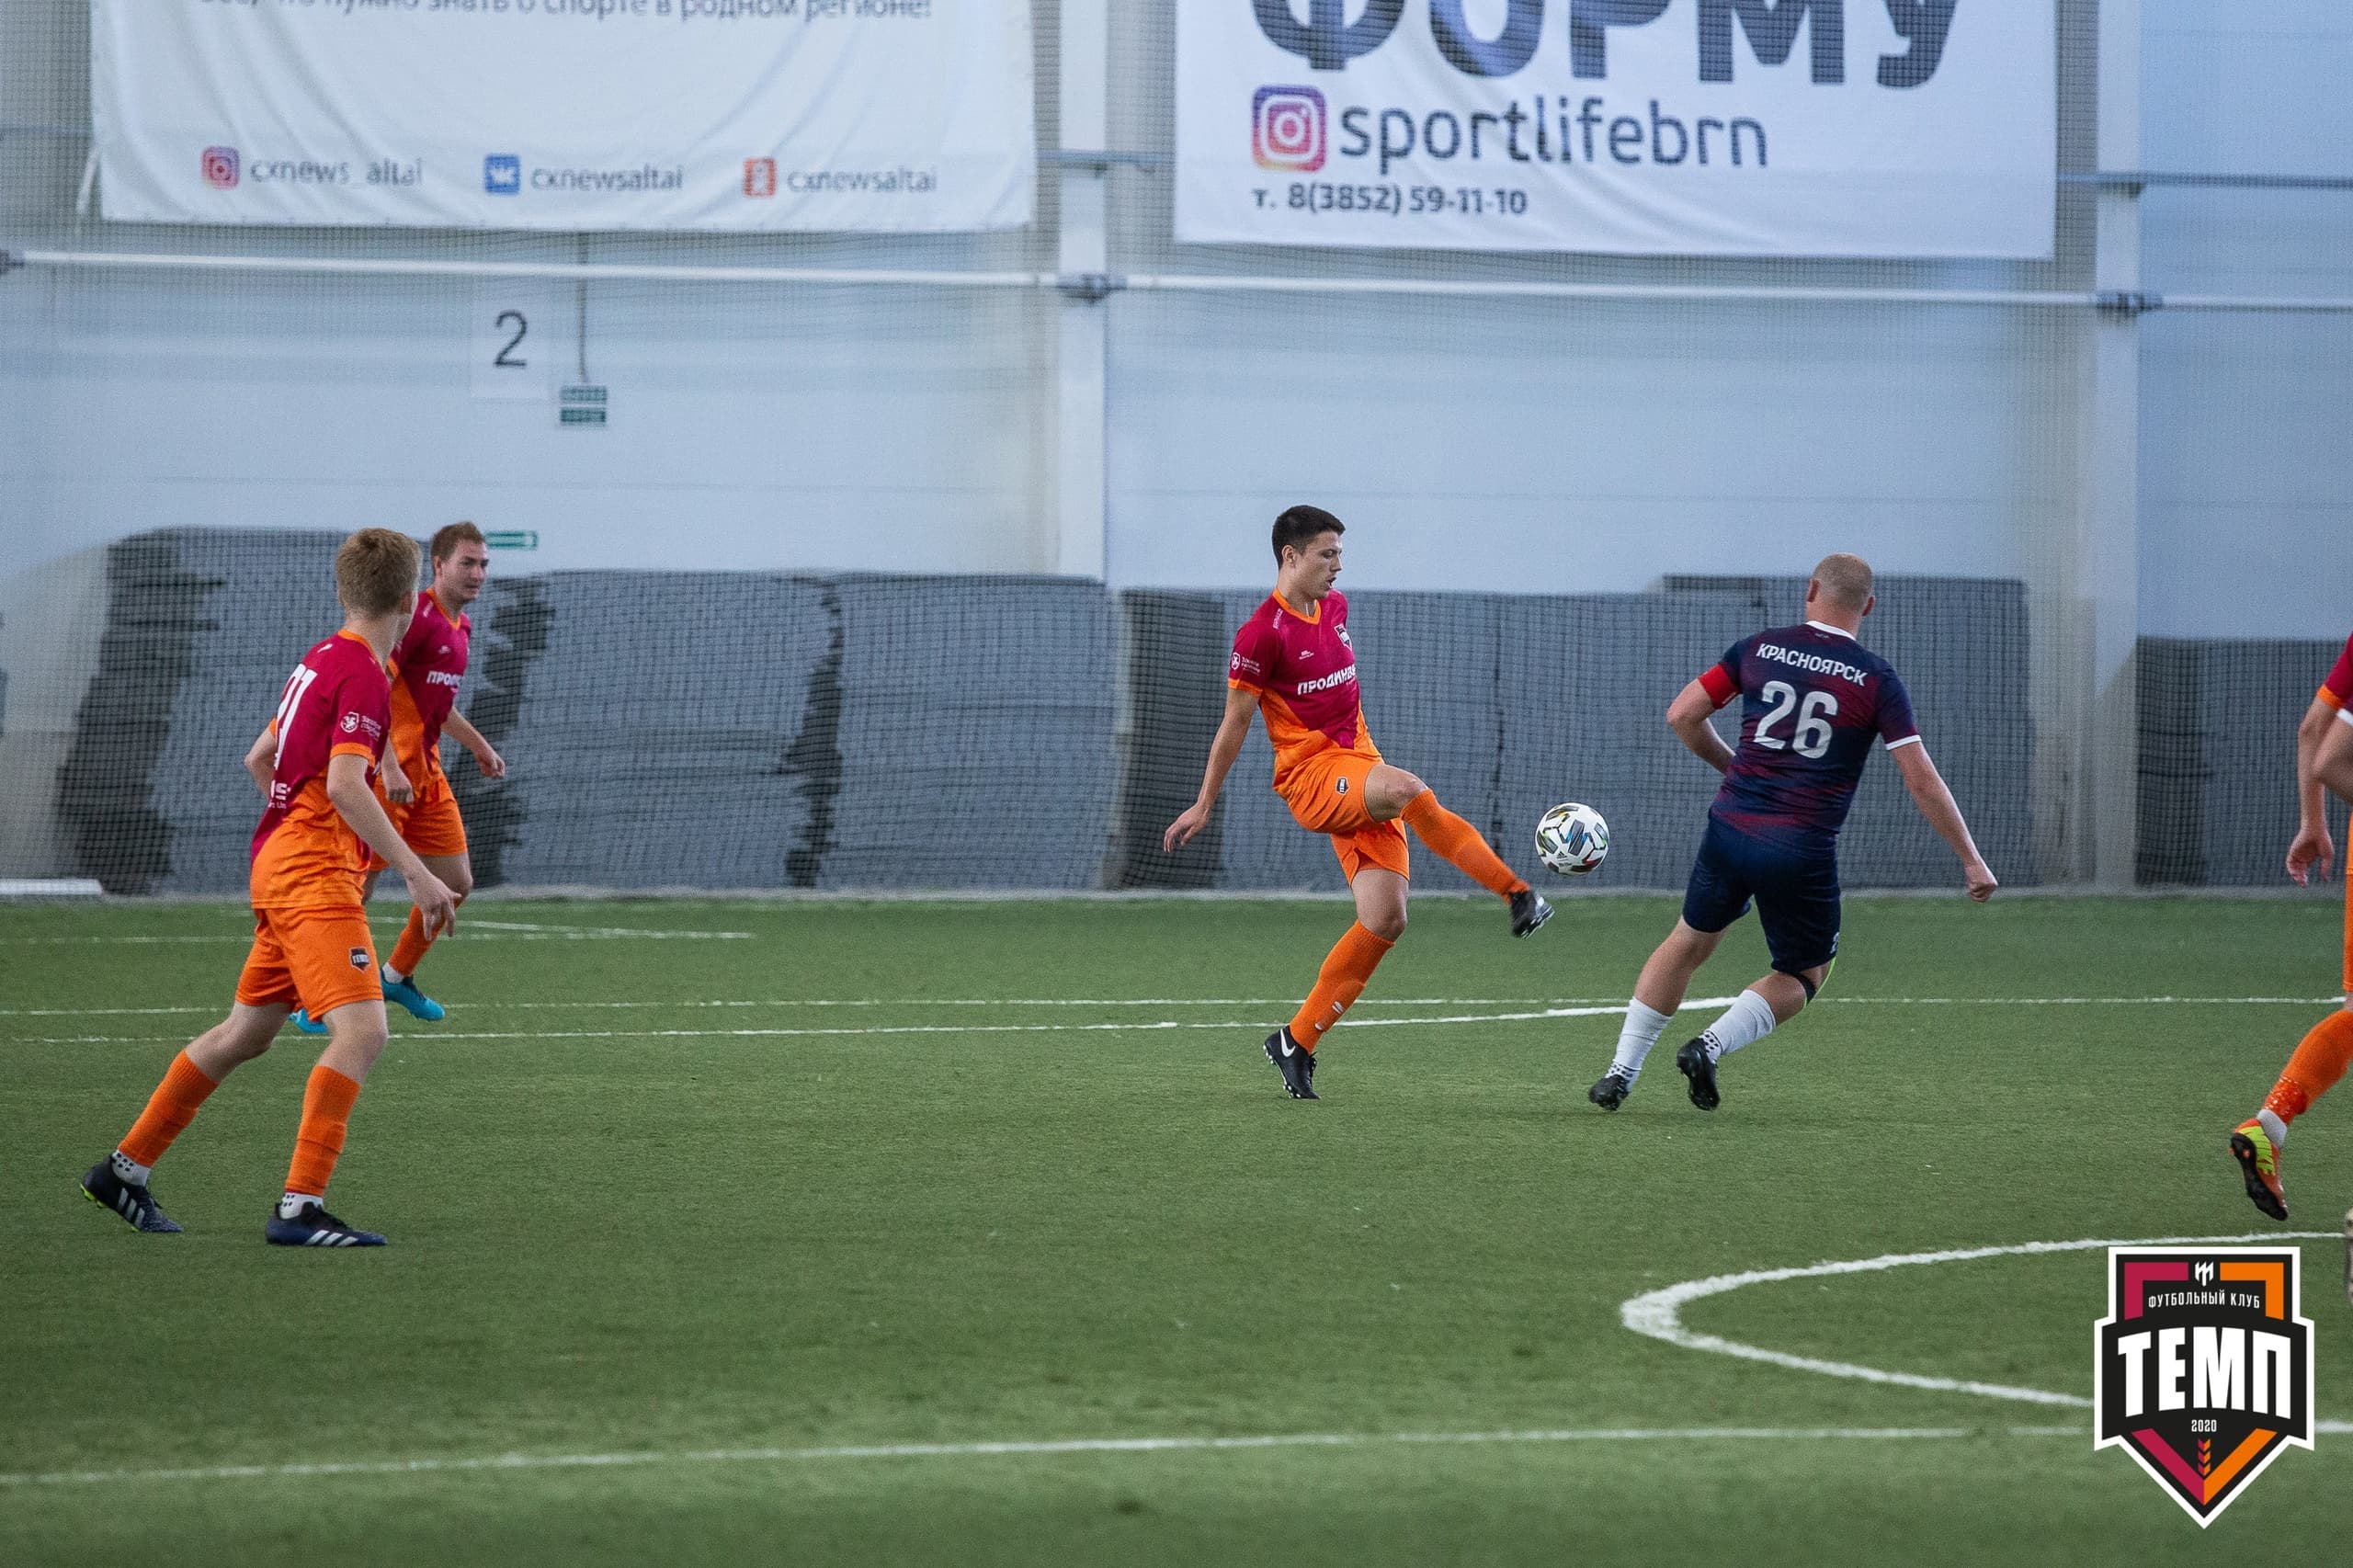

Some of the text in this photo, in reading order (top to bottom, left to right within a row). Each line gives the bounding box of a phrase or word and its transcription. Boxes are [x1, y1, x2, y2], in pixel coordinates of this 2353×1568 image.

[1339, 95, 1768, 176] sportlifebrn
[1288, 183, 1403, 214] 8(3852)
[1410, 186, 1528, 214] 59-11-10
[493, 309, 528, 368] 2
[1756, 643, 1868, 687] КРАСНОЯРСК
[1753, 680, 1838, 759] 26
